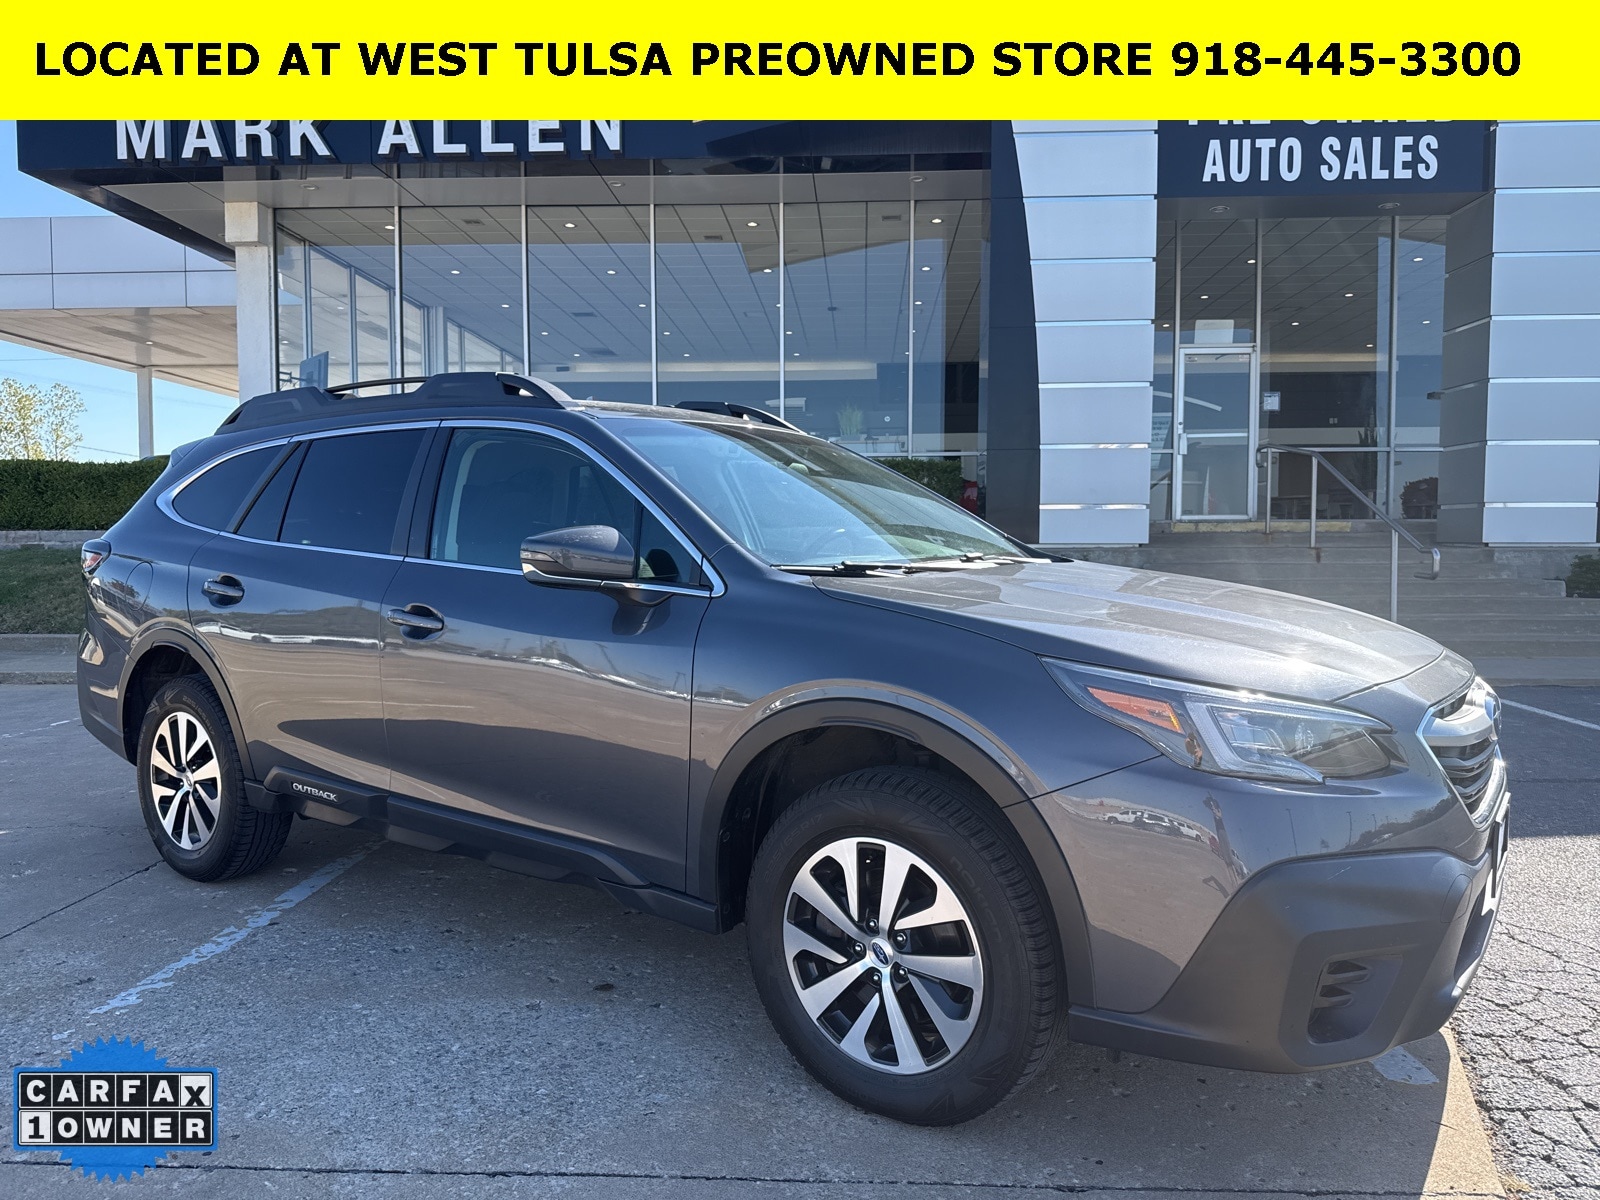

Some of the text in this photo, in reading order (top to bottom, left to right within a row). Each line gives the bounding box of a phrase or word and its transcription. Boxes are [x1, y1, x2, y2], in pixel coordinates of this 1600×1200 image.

[115, 120, 621, 160] MARK ALLEN
[1202, 134, 1439, 183] AUTO SALES
[292, 782, 338, 802] OUTBACK
